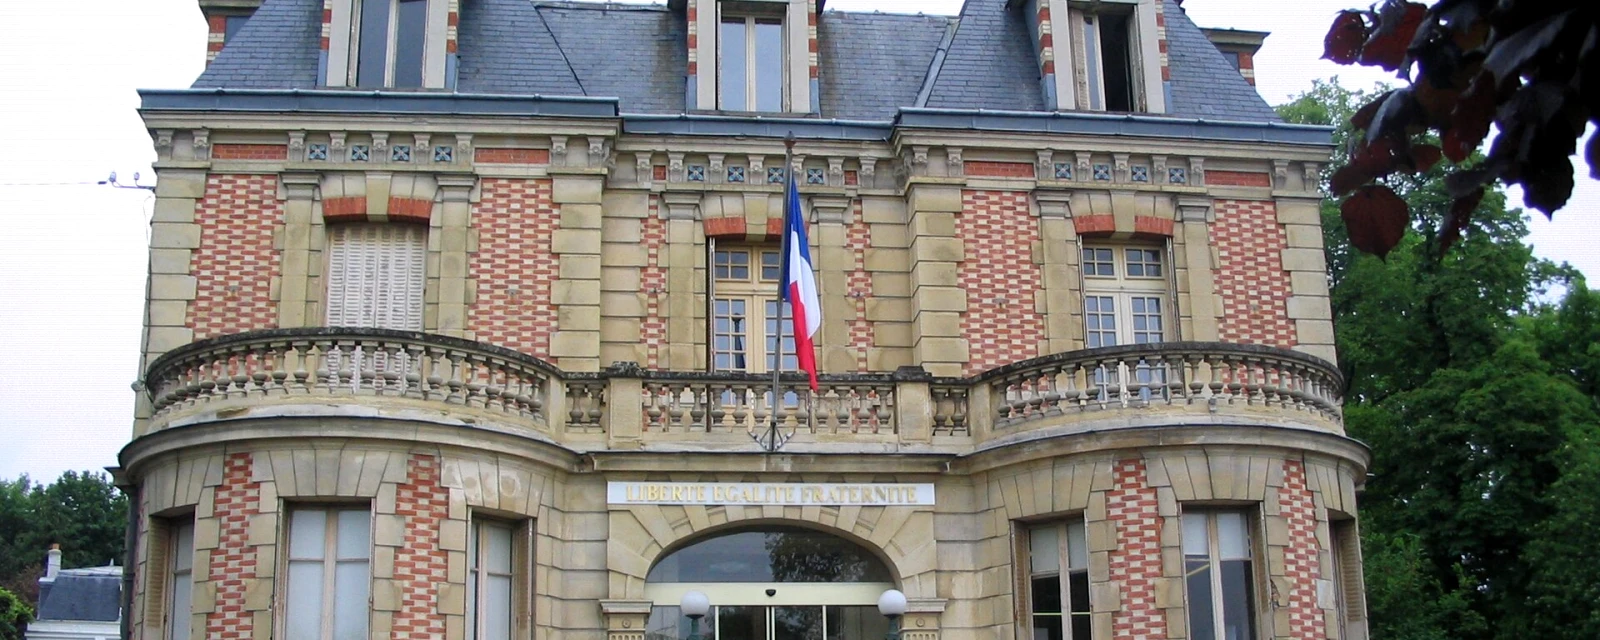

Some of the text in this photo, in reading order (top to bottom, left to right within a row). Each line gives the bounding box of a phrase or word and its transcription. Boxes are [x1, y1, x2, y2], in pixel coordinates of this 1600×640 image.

[626, 485, 917, 503] LIBERTE EGALITE FRATERNITE
